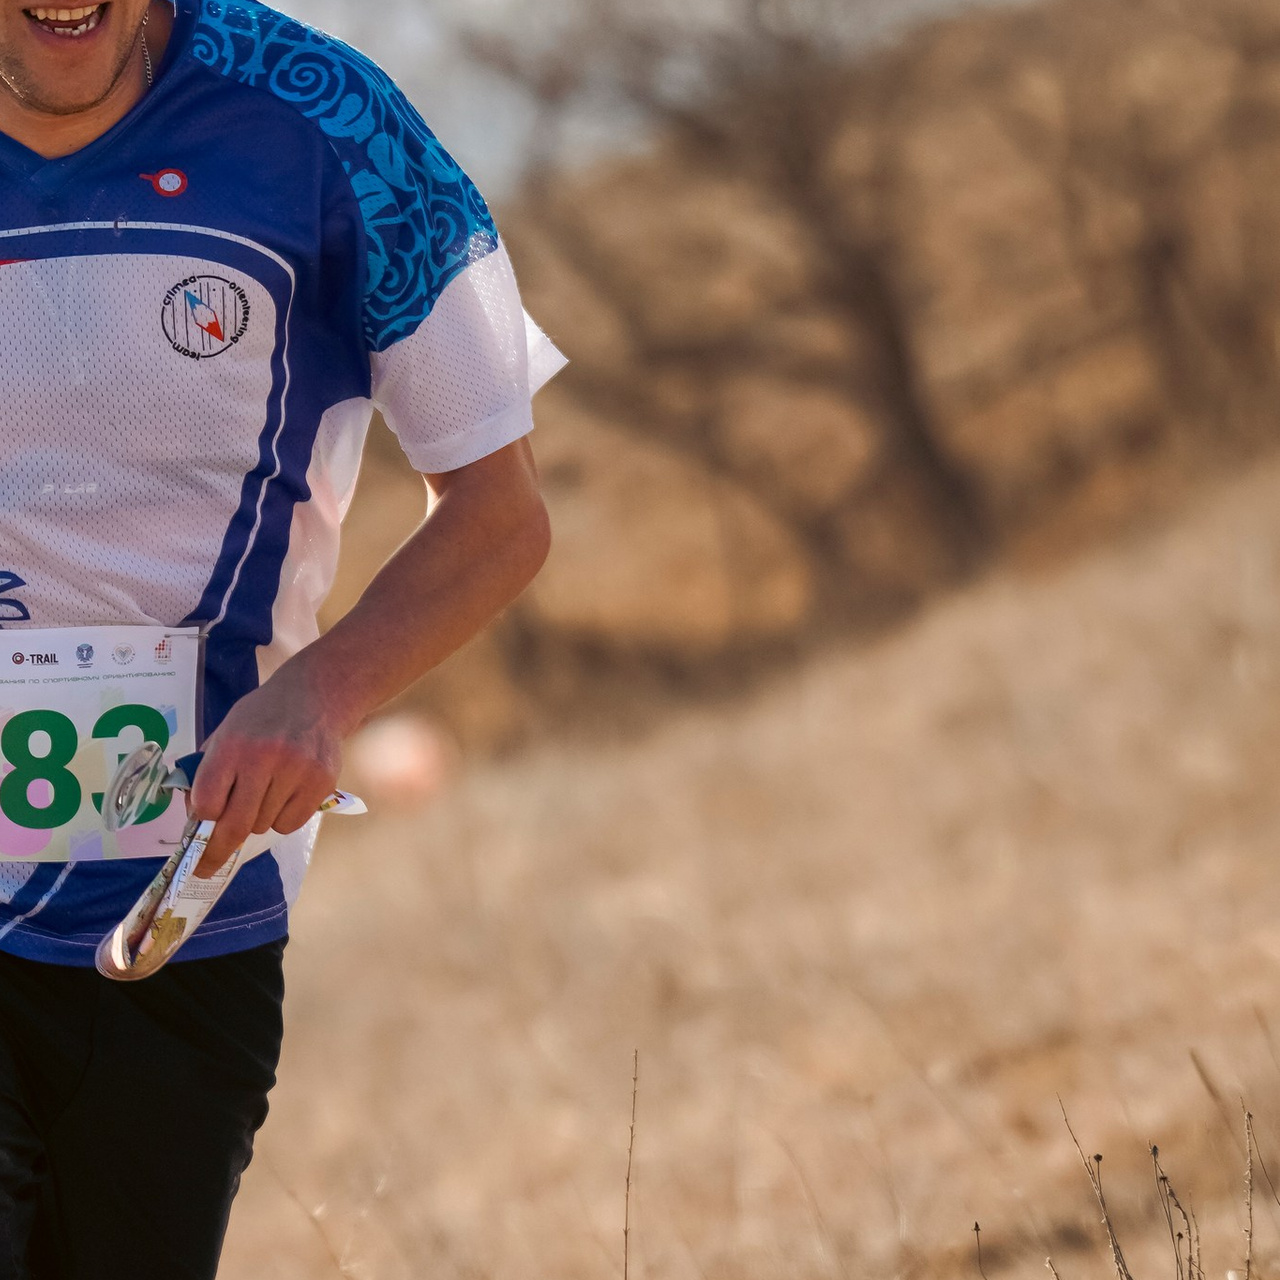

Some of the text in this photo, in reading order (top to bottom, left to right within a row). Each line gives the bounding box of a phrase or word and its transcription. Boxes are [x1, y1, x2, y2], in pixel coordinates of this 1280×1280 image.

[162, 275, 198, 306] crimea
[228, 282, 250, 344] orienteering
[172, 342, 202, 361] team
[42, 483, 97, 494] PLAR
